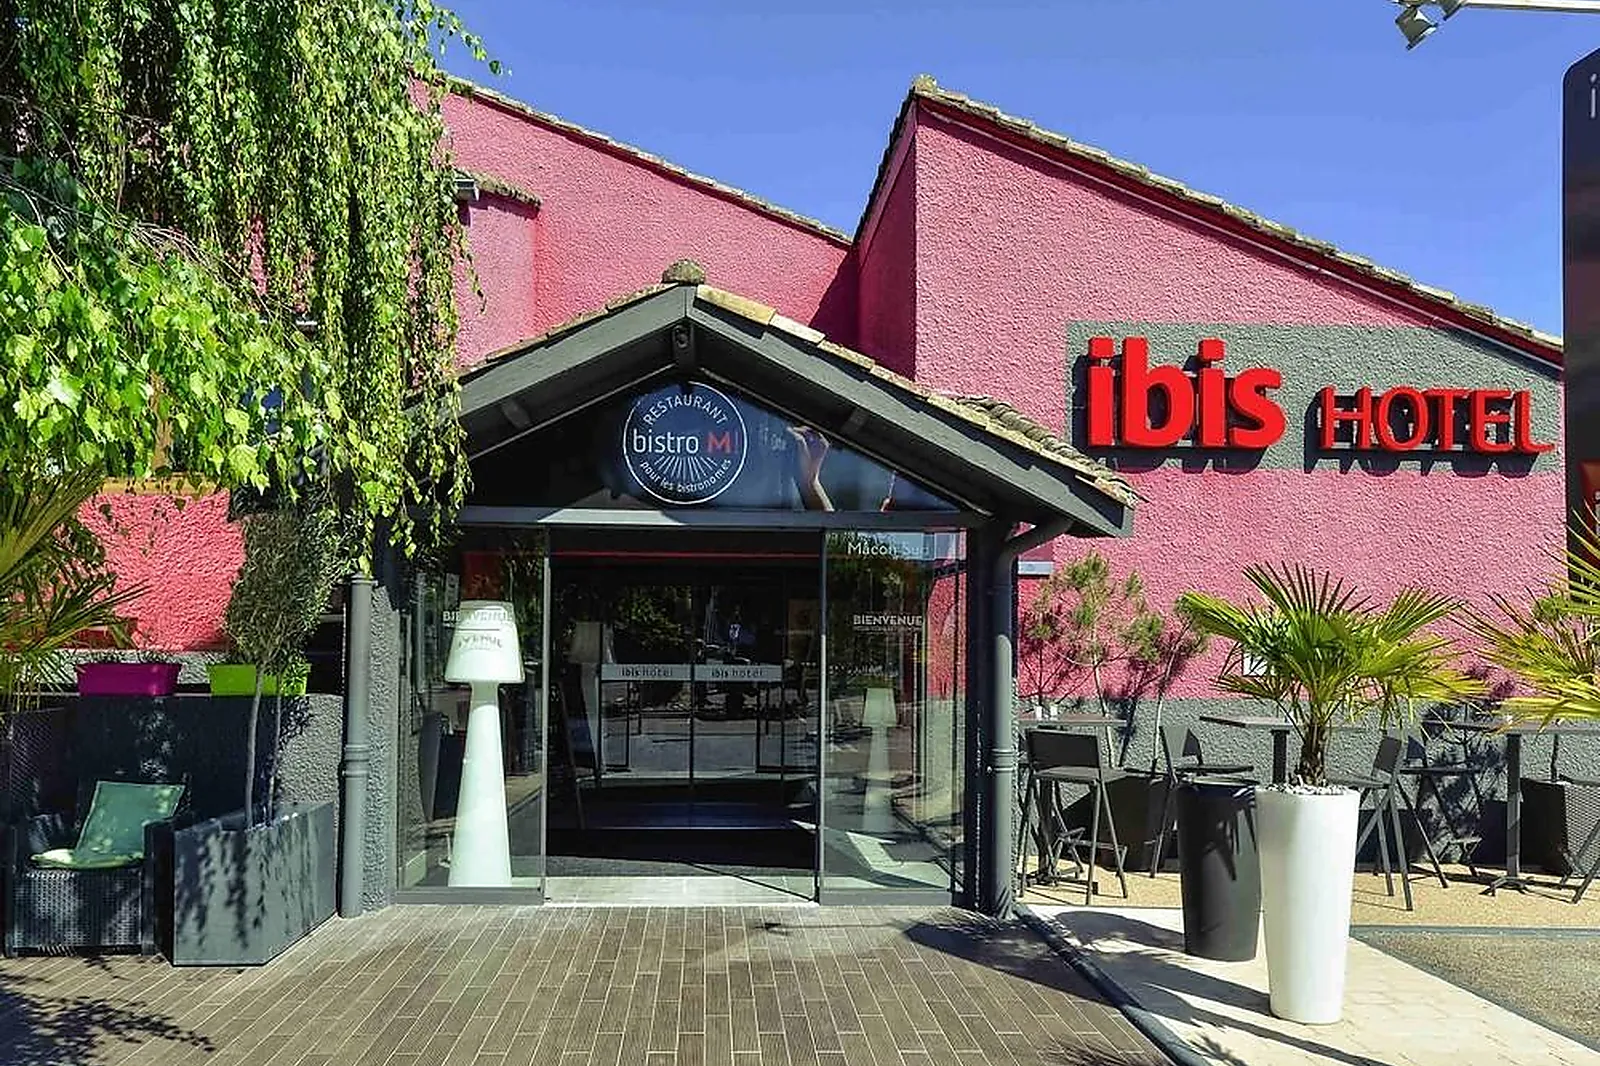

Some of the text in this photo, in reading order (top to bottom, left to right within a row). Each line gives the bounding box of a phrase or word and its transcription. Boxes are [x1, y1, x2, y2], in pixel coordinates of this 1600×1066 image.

[643, 394, 728, 426] RESTAURANT
[1087, 337, 1554, 453] ibis HOTEL
[633, 428, 699, 453] bistro
[640, 460, 661, 483] pour
[660, 477, 674, 491] les
[853, 615, 923, 625] BIENVENUE
